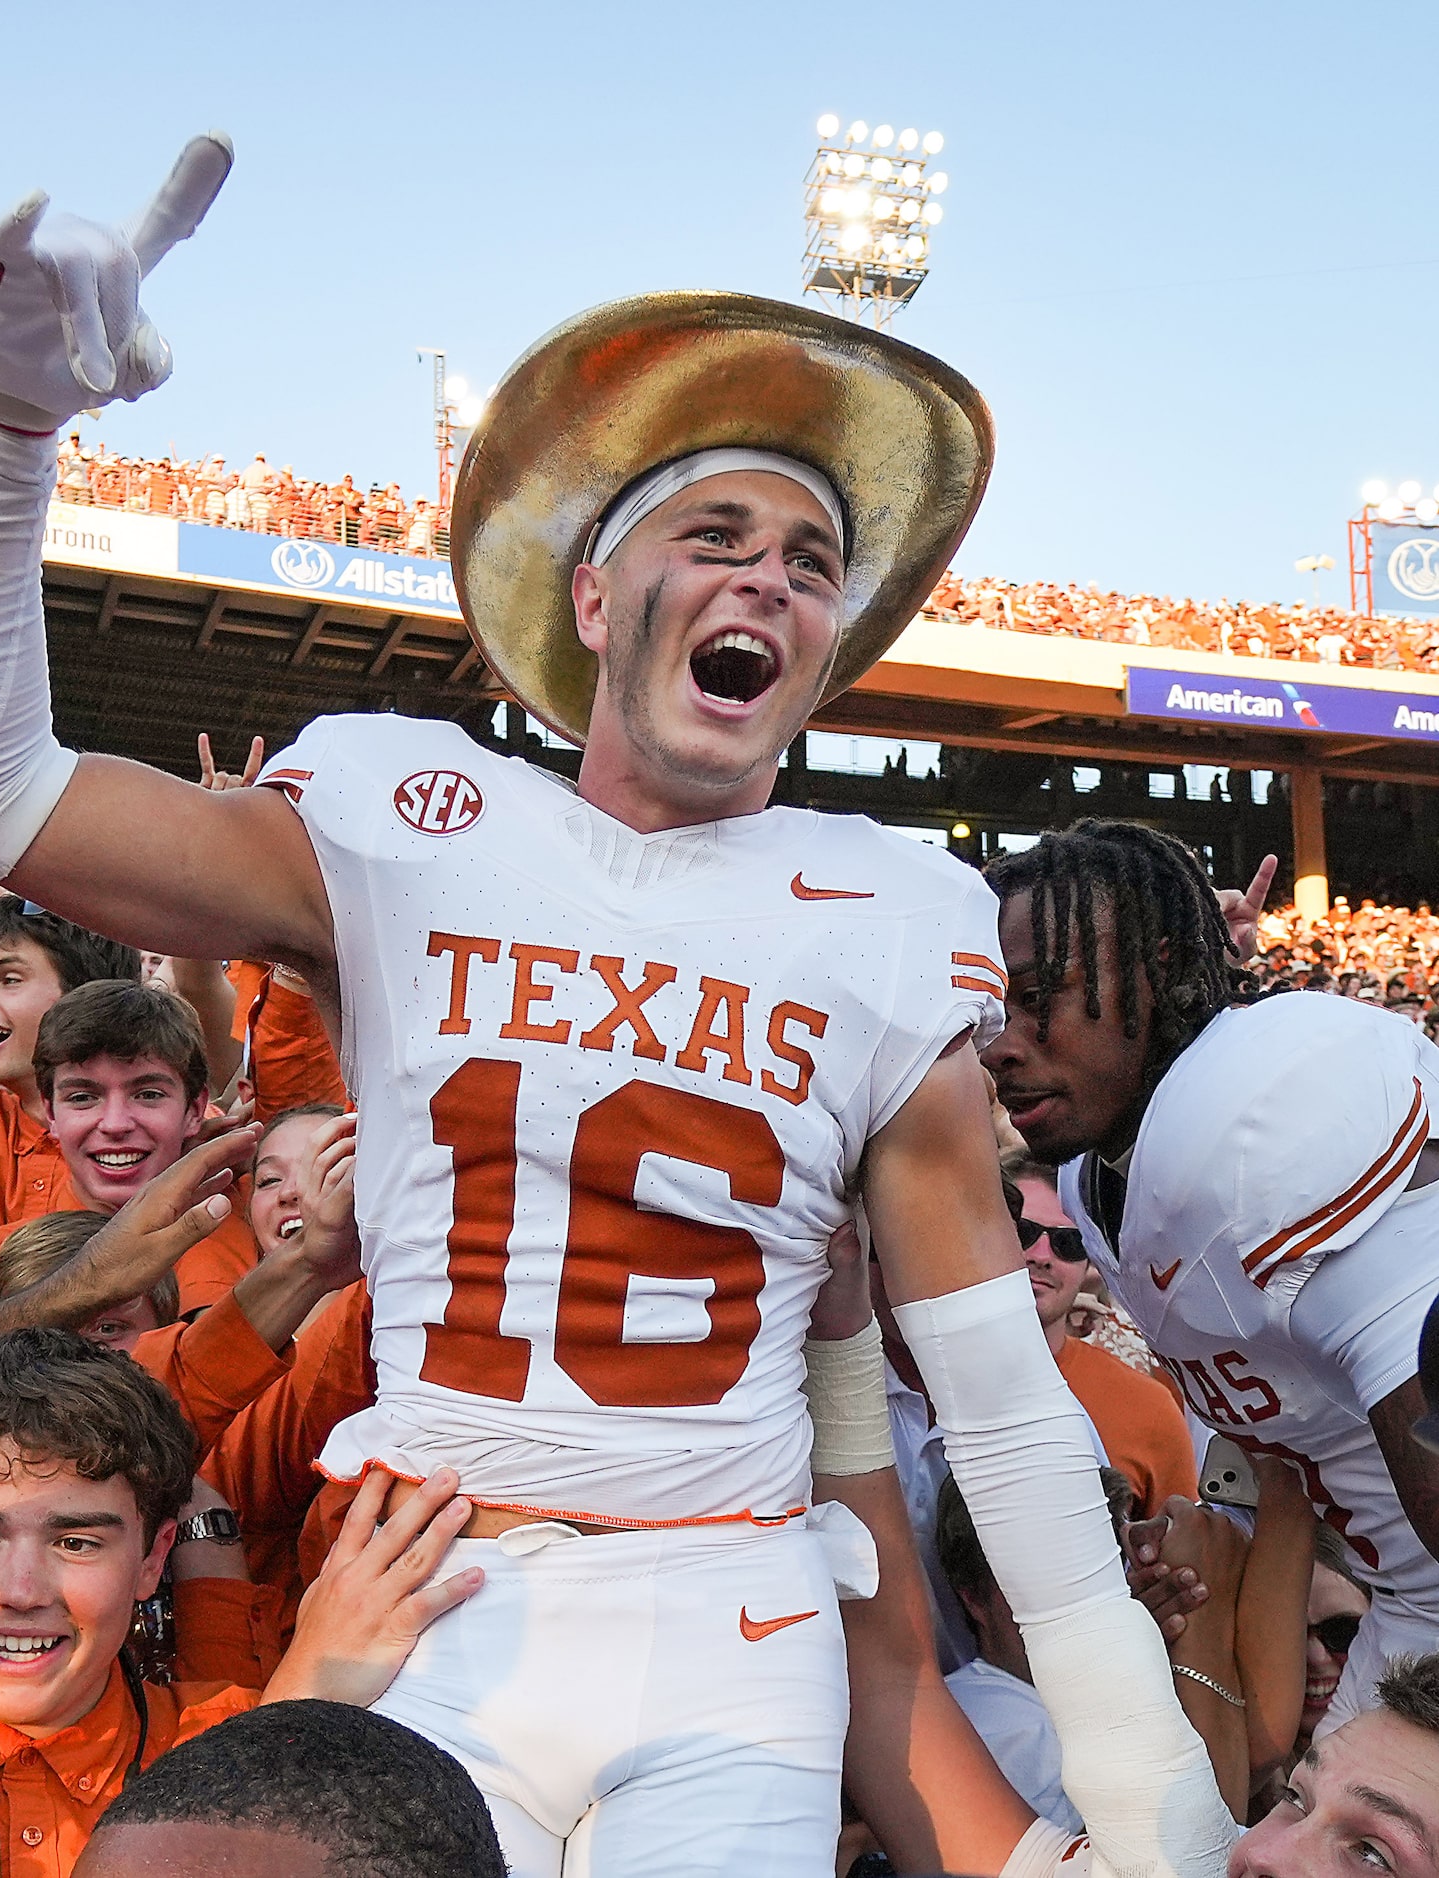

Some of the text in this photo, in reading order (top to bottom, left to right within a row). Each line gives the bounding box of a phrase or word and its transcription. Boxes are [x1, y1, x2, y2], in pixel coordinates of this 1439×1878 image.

[42, 528, 112, 553] rona
[1166, 683, 1284, 719] American
[398, 772, 479, 831] SEC
[426, 930, 830, 1107] TEXAS
[418, 1056, 787, 1408] 16
